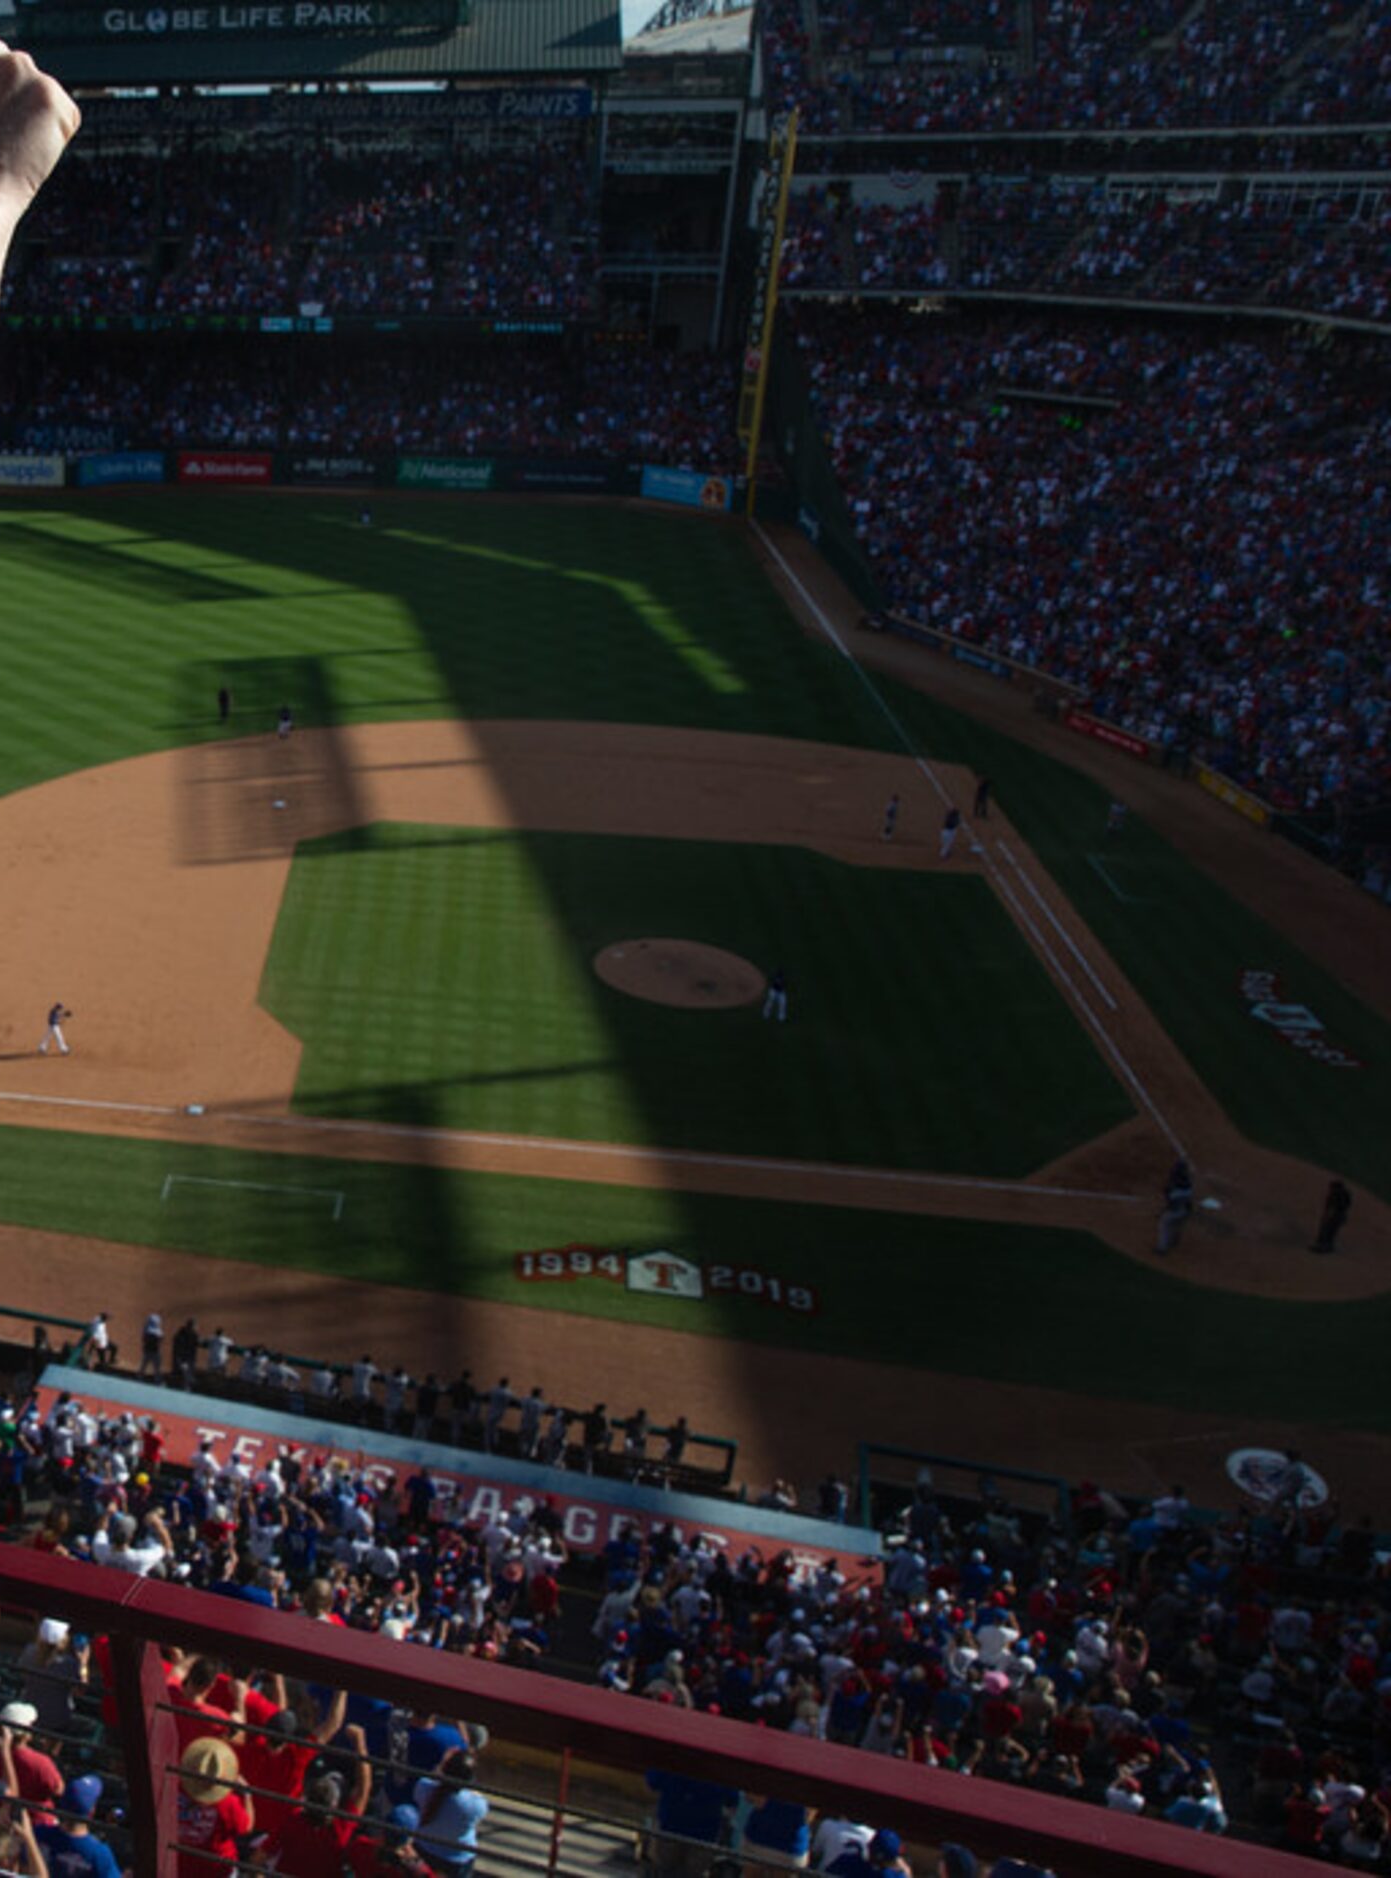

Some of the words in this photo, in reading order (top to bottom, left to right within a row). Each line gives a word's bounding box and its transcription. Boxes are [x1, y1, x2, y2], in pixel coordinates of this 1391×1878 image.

[104, 6, 208, 33] GLOBE
[219, 5, 283, 28] LIFE
[293, 4, 372, 25] PARK
[496, 91, 581, 114] PAINTS
[518, 1250, 625, 1280] 1994
[644, 1259, 687, 1291] T
[707, 1264, 815, 1313] 2019
